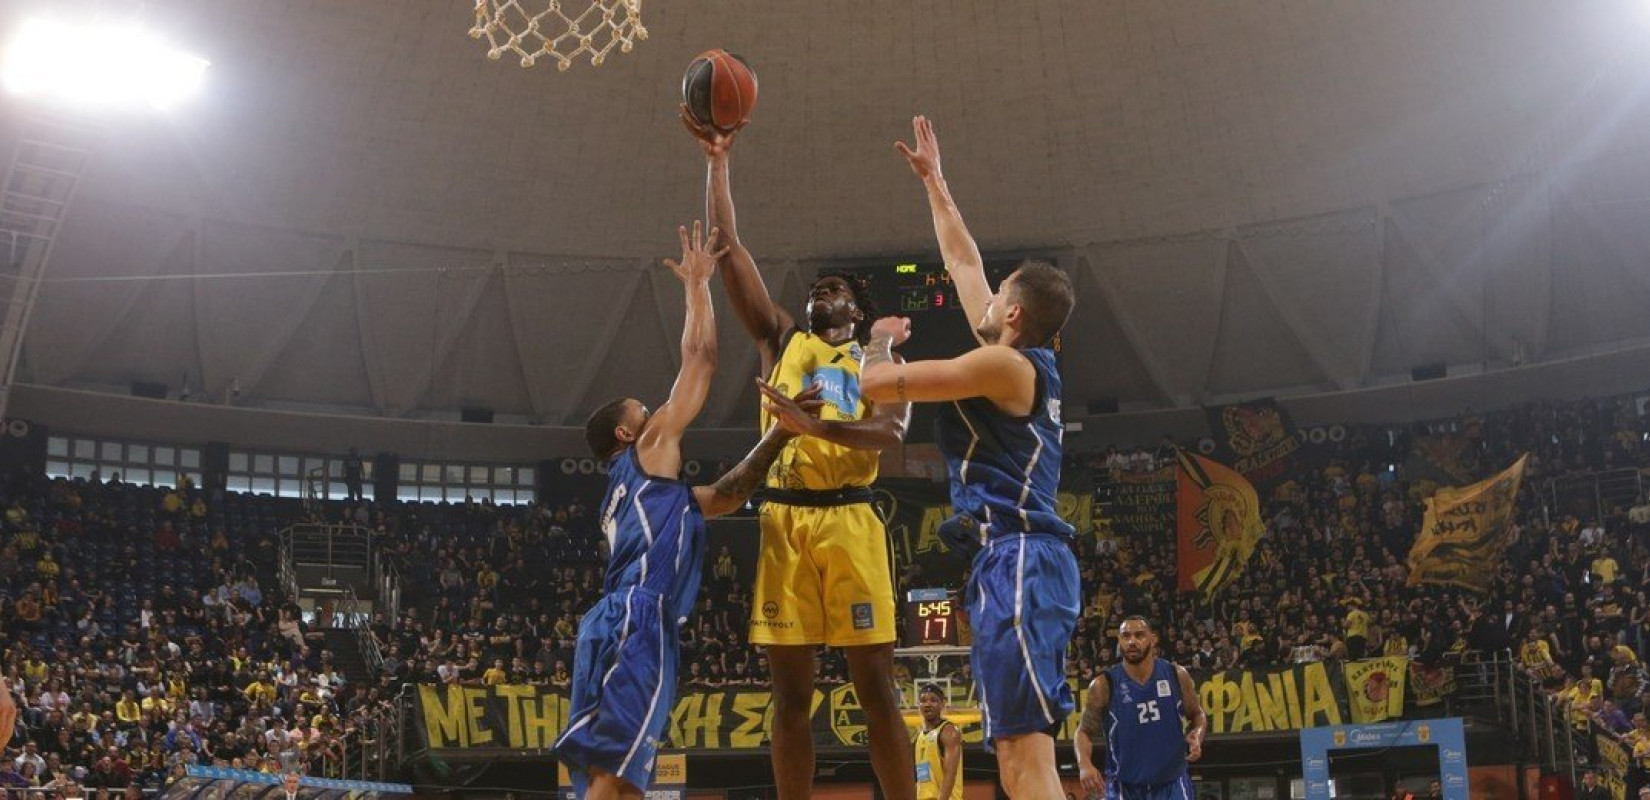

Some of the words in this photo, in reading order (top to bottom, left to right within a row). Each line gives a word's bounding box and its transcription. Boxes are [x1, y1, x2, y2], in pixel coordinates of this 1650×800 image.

[896, 263, 918, 273] HOME
[918, 601, 951, 617] 6:45
[924, 618, 947, 638] 17
[1199, 662, 1343, 733] ΦΑΝΙΑ
[1136, 700, 1160, 724] 25
